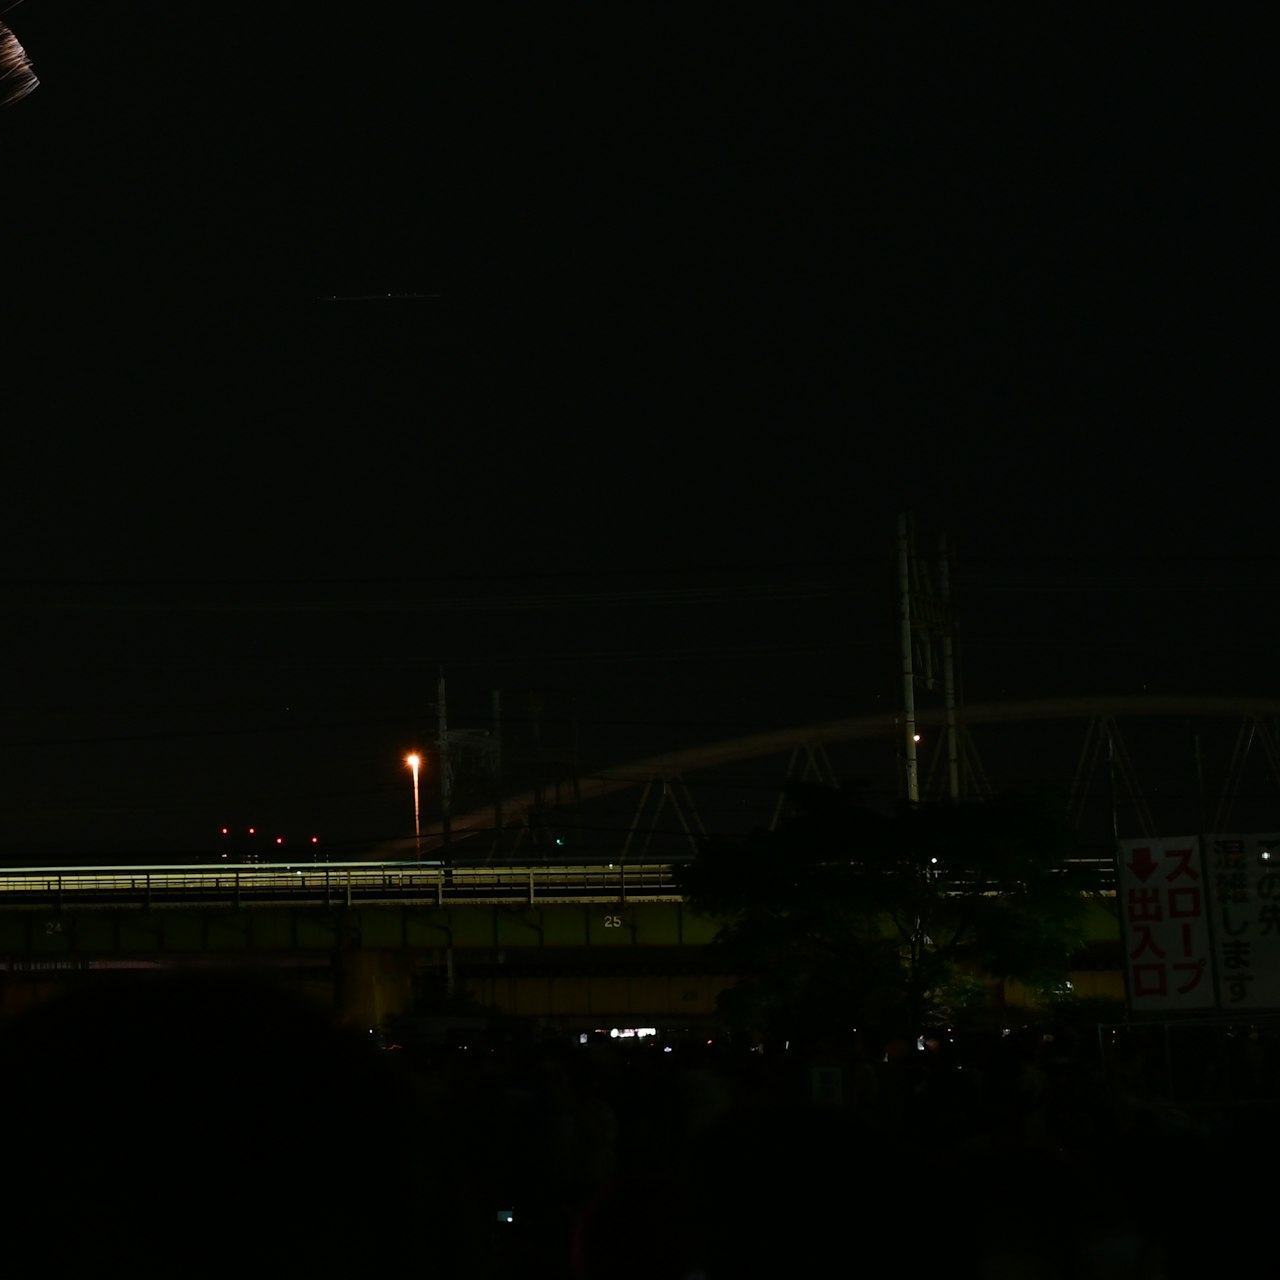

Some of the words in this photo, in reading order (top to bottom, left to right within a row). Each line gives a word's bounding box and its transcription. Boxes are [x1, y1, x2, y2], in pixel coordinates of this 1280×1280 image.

[604, 915, 622, 928] 25
[1128, 887, 1168, 996] 出入口
[1165, 848, 1208, 994] スロープ
